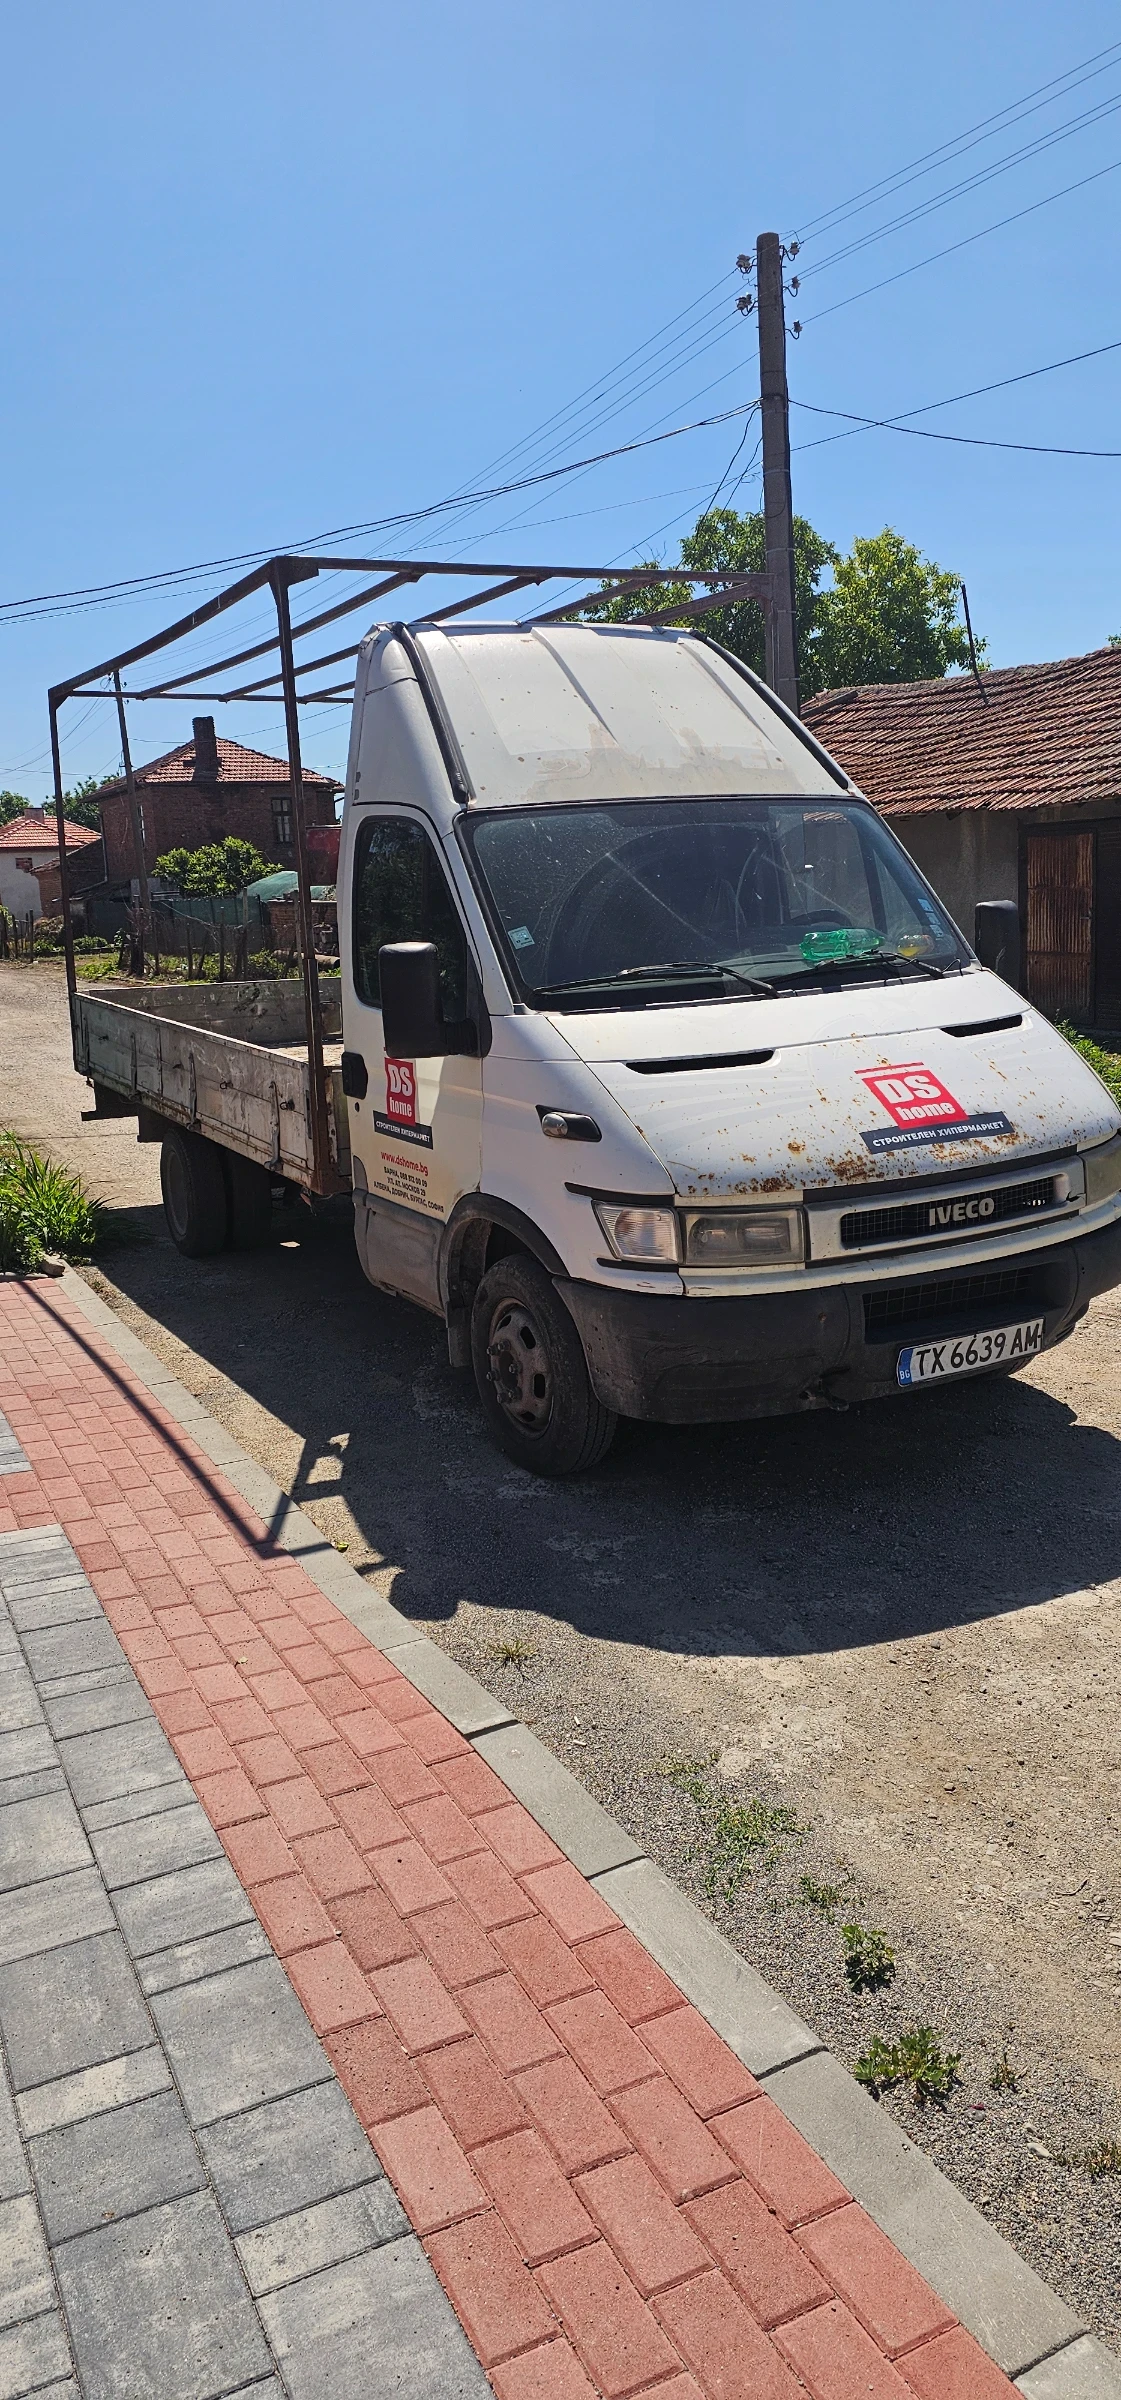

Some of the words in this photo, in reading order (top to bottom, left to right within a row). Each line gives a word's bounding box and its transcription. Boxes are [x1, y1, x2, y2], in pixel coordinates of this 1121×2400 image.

[388, 1064, 413, 1097] DS
[873, 1075, 942, 1104] DS
[389, 1096, 413, 1118] home
[895, 1102, 956, 1121] home
[376, 1120, 401, 1134] СТРОИТЕЛЕН
[401, 1128, 430, 1142] ХИПЕРМАРКЕТ
[872, 1130, 937, 1147] СТРОИТЕЛЕН
[938, 1120, 1004, 1137] ХИПЕРМАРКЕТ
[381, 1152, 429, 1177] www.dshome.bg
[929, 1197, 995, 1227] IVECO
[900, 1369, 911, 1380] BG
[916, 1345, 947, 1377] TX
[950, 1332, 1007, 1369] 6639
[1010, 1323, 1040, 1356] AM
